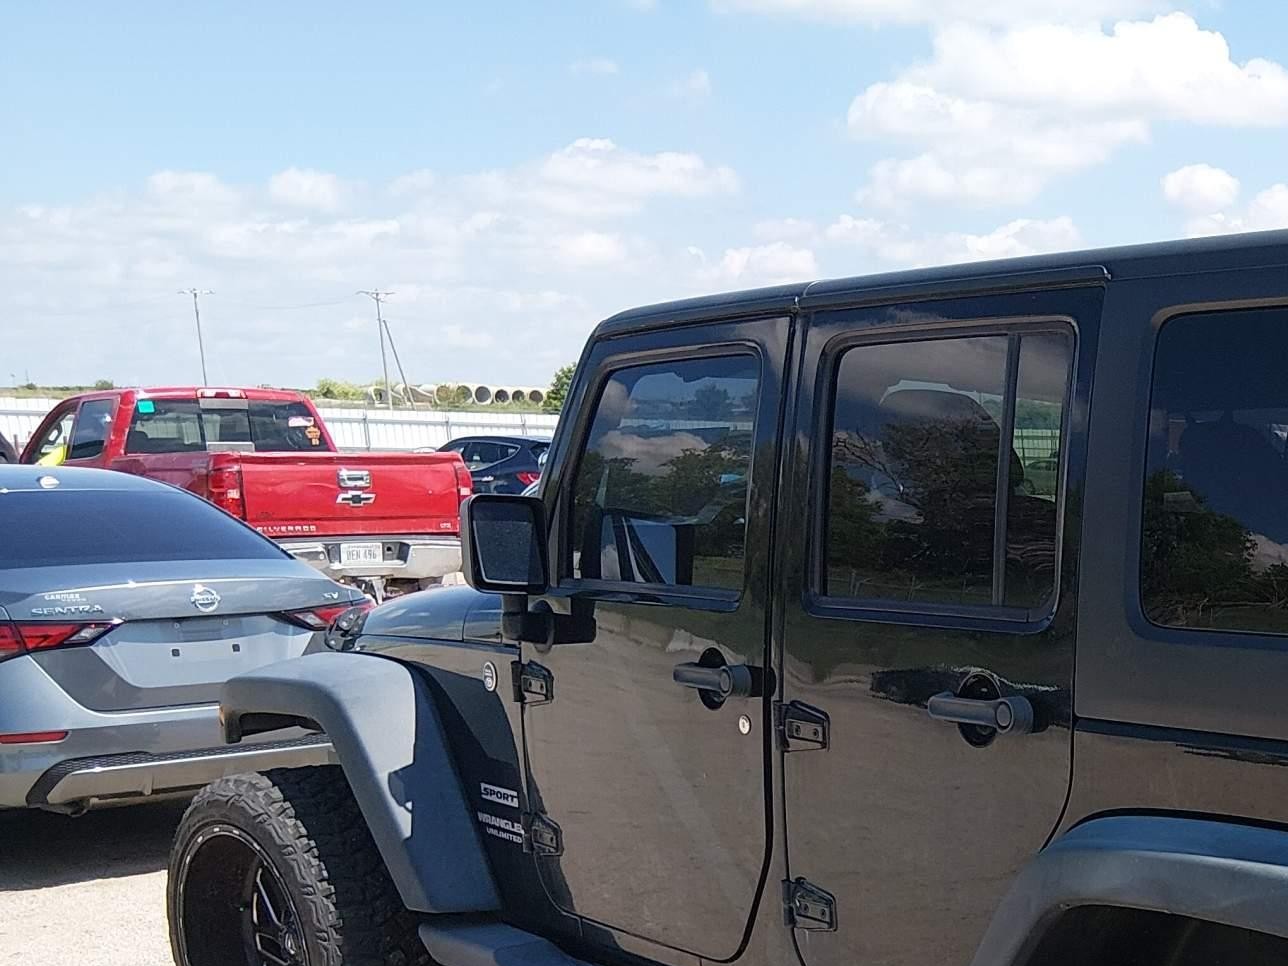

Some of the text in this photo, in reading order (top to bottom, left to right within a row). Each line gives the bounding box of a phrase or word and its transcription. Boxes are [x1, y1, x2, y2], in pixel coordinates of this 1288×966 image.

[31, 604, 104, 616] SENTRA
[482, 787, 519, 802] SPORT
[486, 826, 523, 844] UNLIMITED
